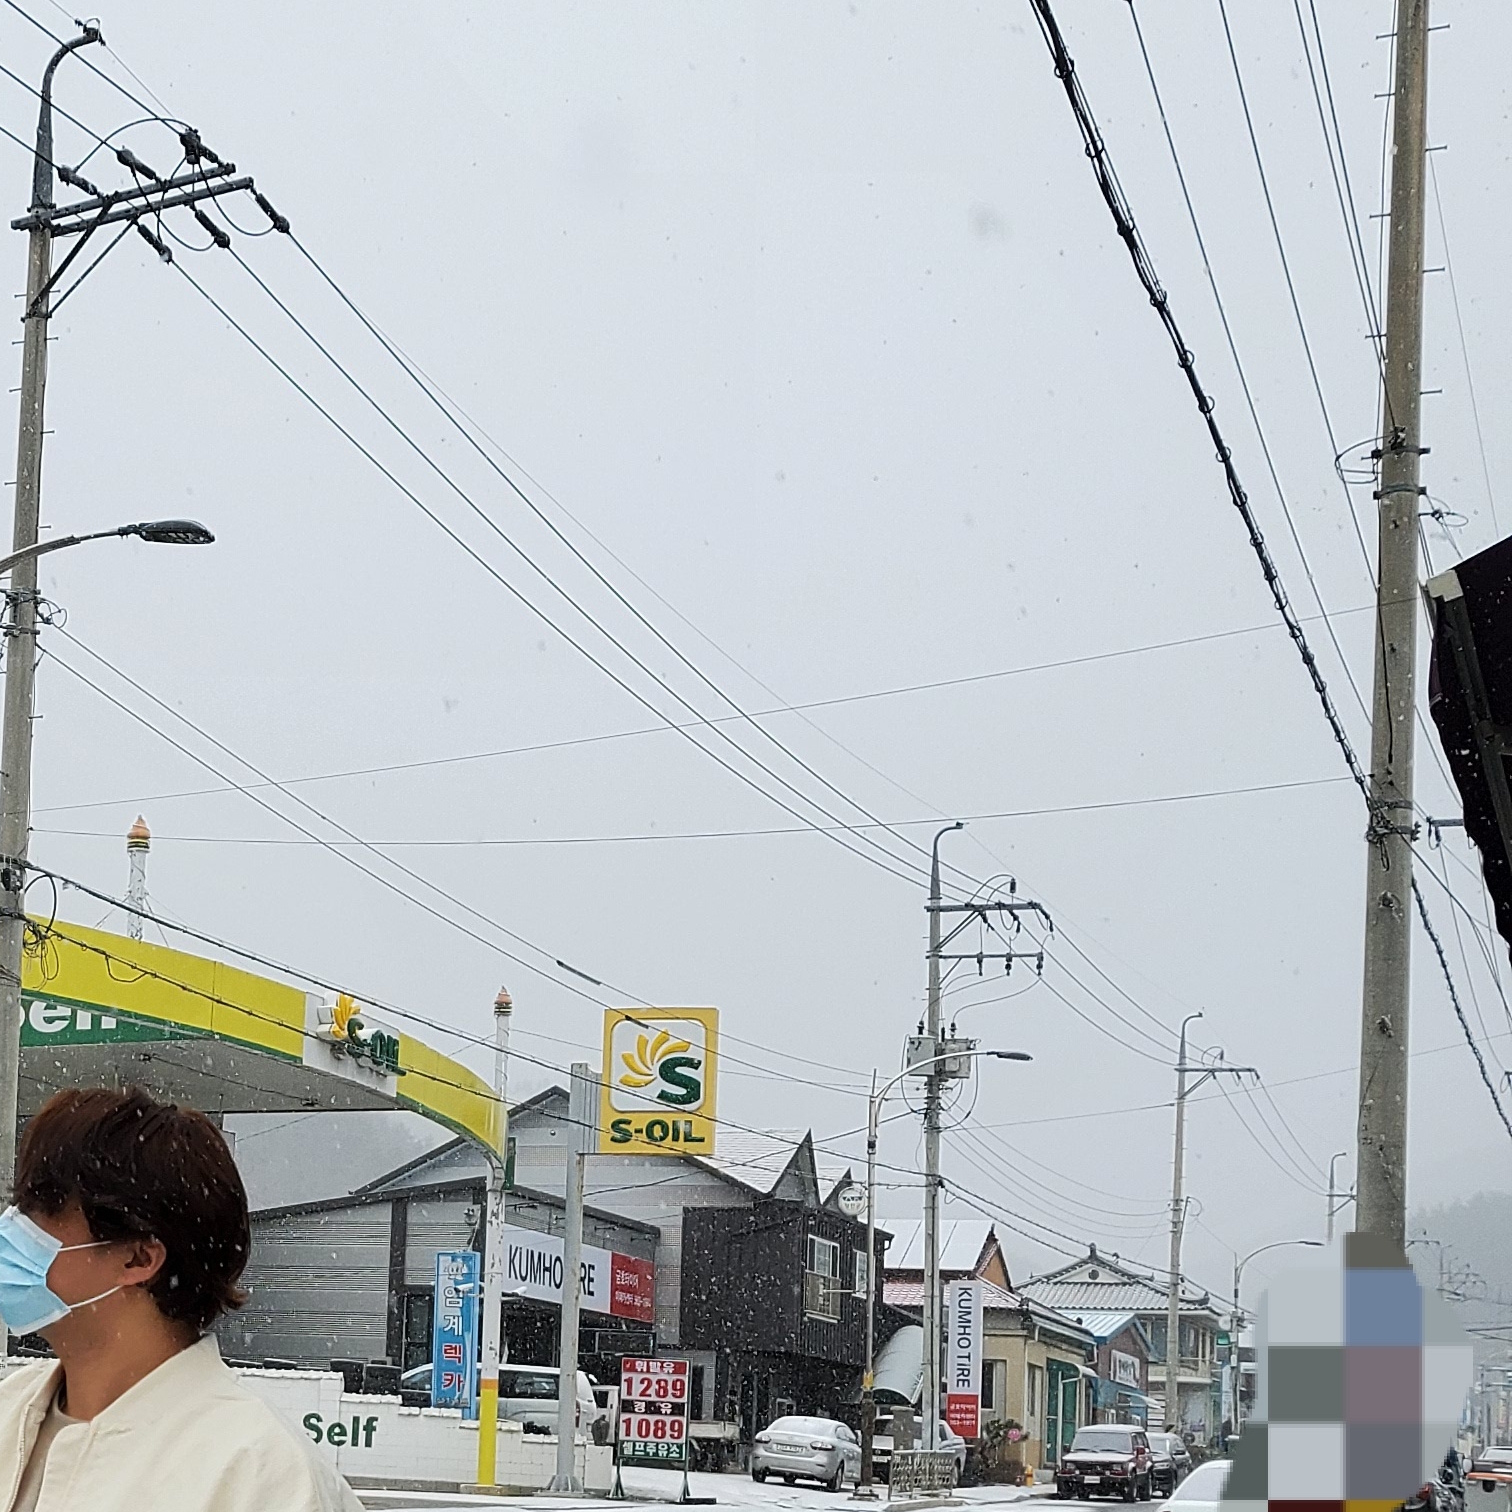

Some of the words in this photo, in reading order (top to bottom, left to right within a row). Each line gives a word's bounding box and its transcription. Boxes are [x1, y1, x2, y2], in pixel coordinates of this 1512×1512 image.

[610, 1118, 706, 1144] S-OIL
[508, 1244, 564, 1290] KUMHO
[580, 1262, 596, 1297] RE
[957, 1286, 973, 1350] KUMHO
[635, 1360, 675, 1374] 휘발유
[956, 1351, 972, 1389] TIRE
[623, 1376, 686, 1399] 1289
[303, 1412, 379, 1448] Self
[622, 1417, 684, 1440] 1089
[622, 1441, 680, 1458] 셀프주유소
